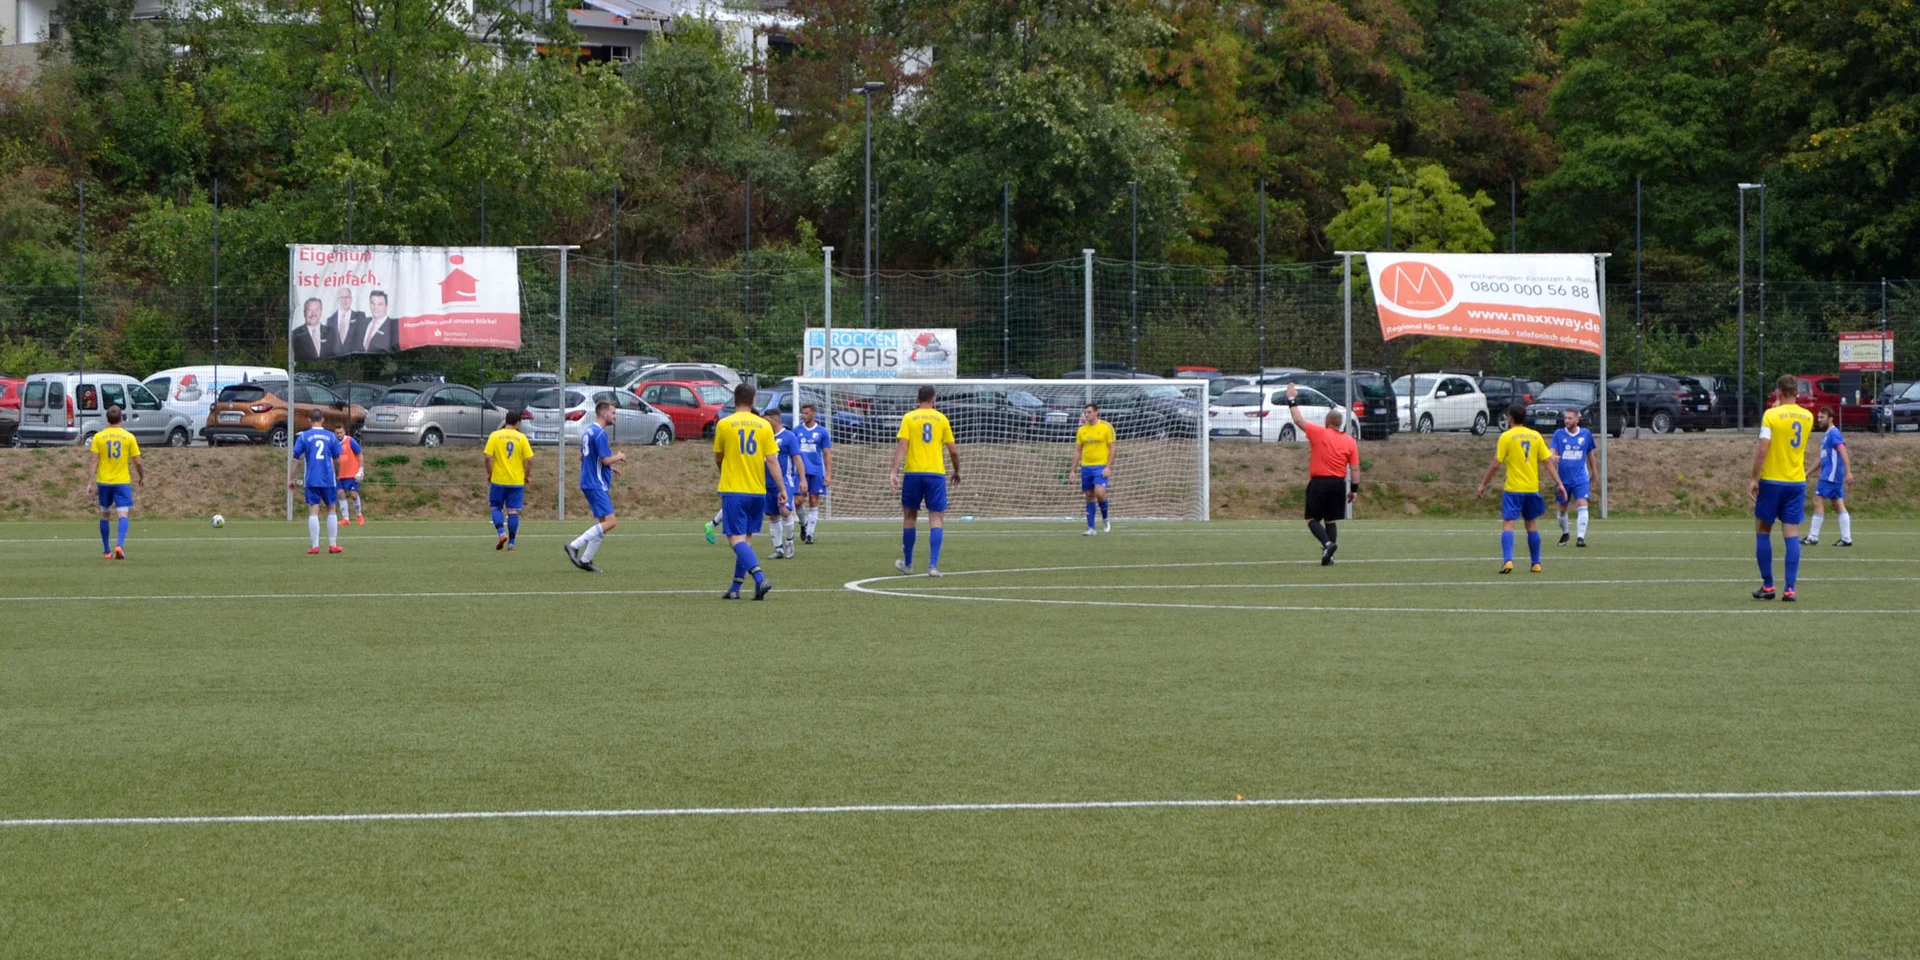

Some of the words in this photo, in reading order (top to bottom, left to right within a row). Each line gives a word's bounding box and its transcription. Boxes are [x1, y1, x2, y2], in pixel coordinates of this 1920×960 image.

[299, 247, 373, 266] Eigentum
[298, 271, 320, 287] ist
[323, 270, 382, 287] einfach.
[1470, 281, 1509, 294] 0800
[1514, 283, 1543, 296] 000
[1547, 284, 1567, 296] 56
[1571, 285, 1590, 299] 88
[1467, 309, 1600, 333] www.maxxway.de
[819, 332, 897, 347] TROCKEN
[1386, 323, 1422, 334] Regional
[1424, 322, 1436, 331] für
[1437, 323, 1450, 332] Sie
[1452, 324, 1463, 333] da
[1469, 326, 1510, 337] persönlich
[1516, 330, 1559, 341] telefonisch
[1560, 335, 1578, 344] oder
[809, 347, 898, 367] PROFIS
[737, 429, 758, 456] 16
[923, 422, 933, 444] 8
[1790, 421, 1802, 448] 3
[106, 440, 122, 459] 13
[315, 440, 325, 460] 2
[505, 441, 515, 459] 9
[1520, 440, 1532, 462] 7
